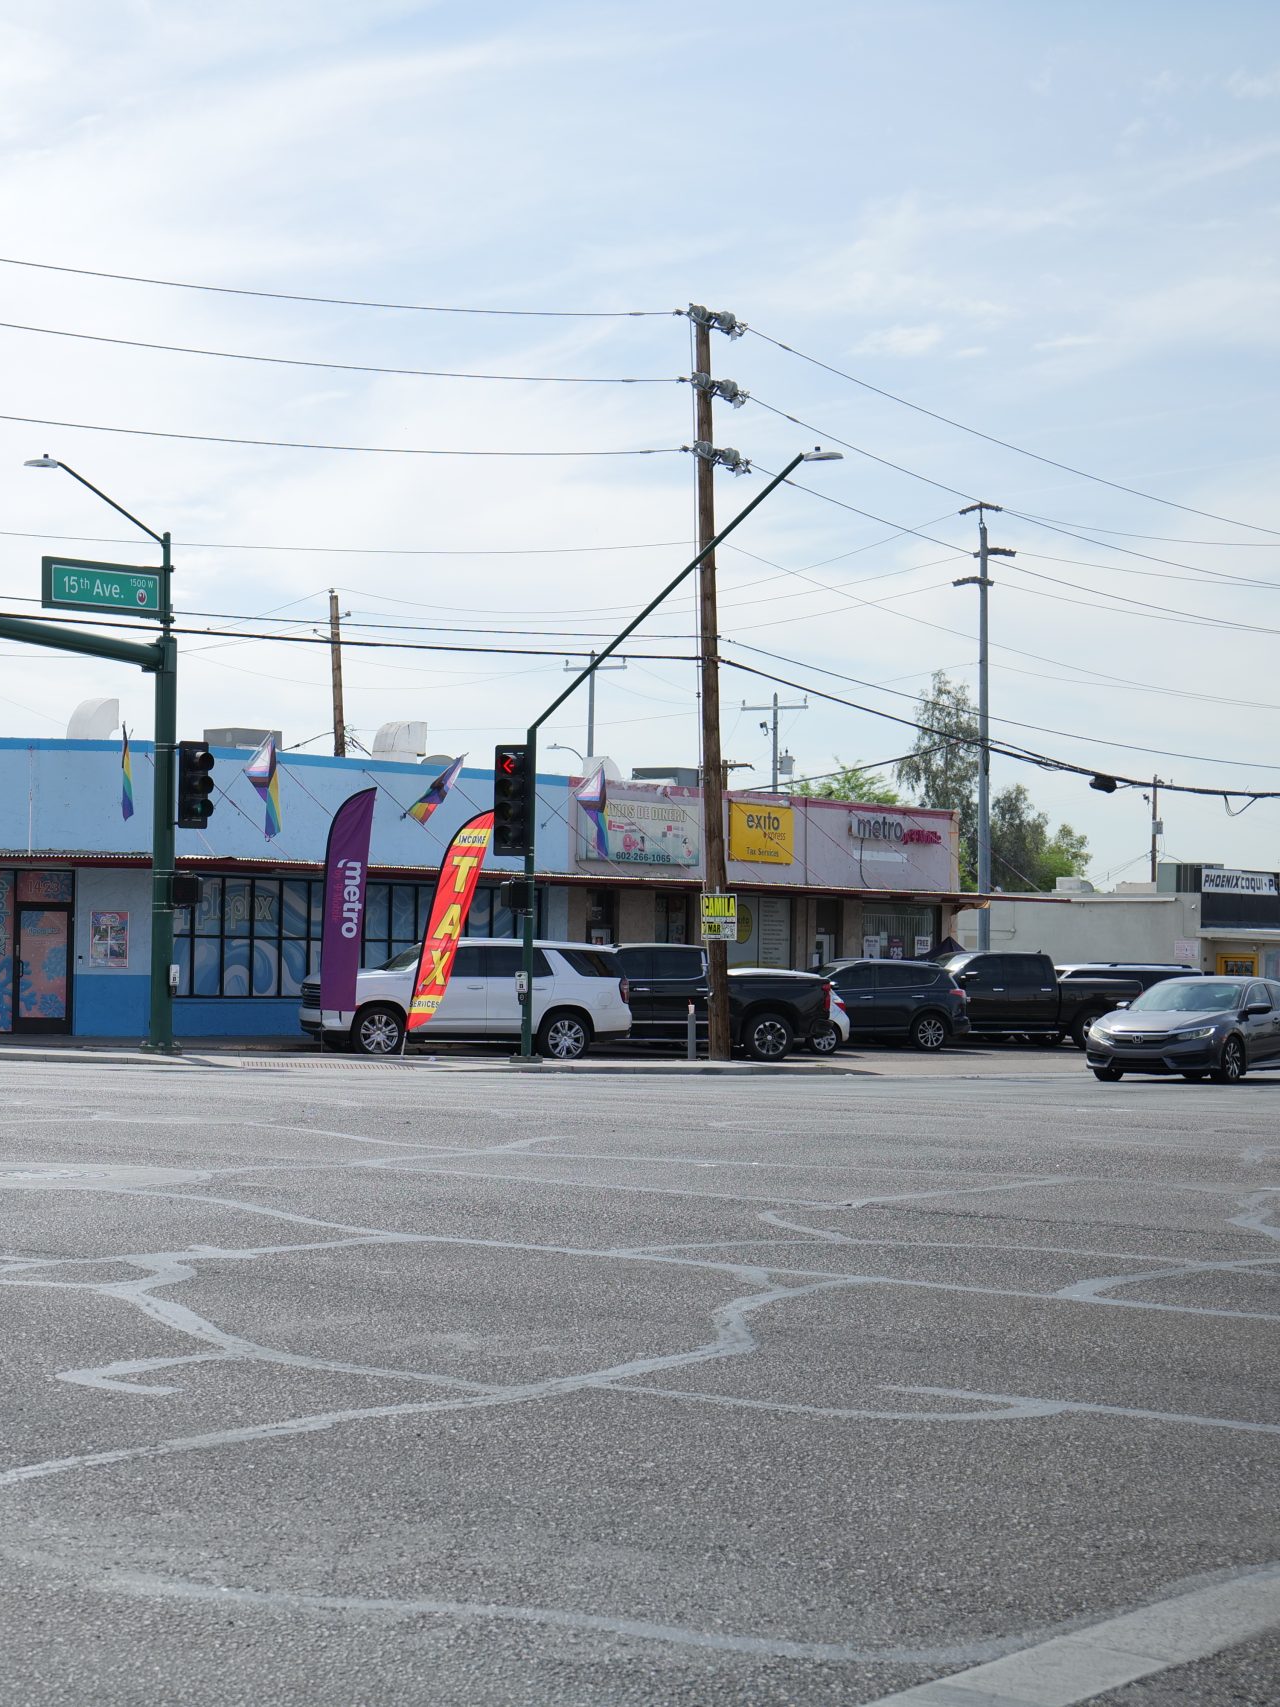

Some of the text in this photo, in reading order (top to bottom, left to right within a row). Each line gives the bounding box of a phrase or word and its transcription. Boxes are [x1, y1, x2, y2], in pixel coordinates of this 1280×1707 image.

[63, 575, 124, 599] 15th Ave.
[130, 578, 154, 589] 1500 W
[636, 806, 651, 820] DE
[651, 807, 688, 823] DINERO
[857, 816, 903, 841] metro
[457, 834, 487, 845] INCOME
[615, 851, 671, 863] 602-266-1065
[746, 846, 780, 858] Tax Services
[28, 880, 62, 895] 1423
[1203, 874, 1240, 889] PHOENIX
[1240, 876, 1263, 893] COQUI
[339, 860, 363, 939] metro
[702, 896, 737, 917] CAMILA
[422, 855, 479, 987] TAX
